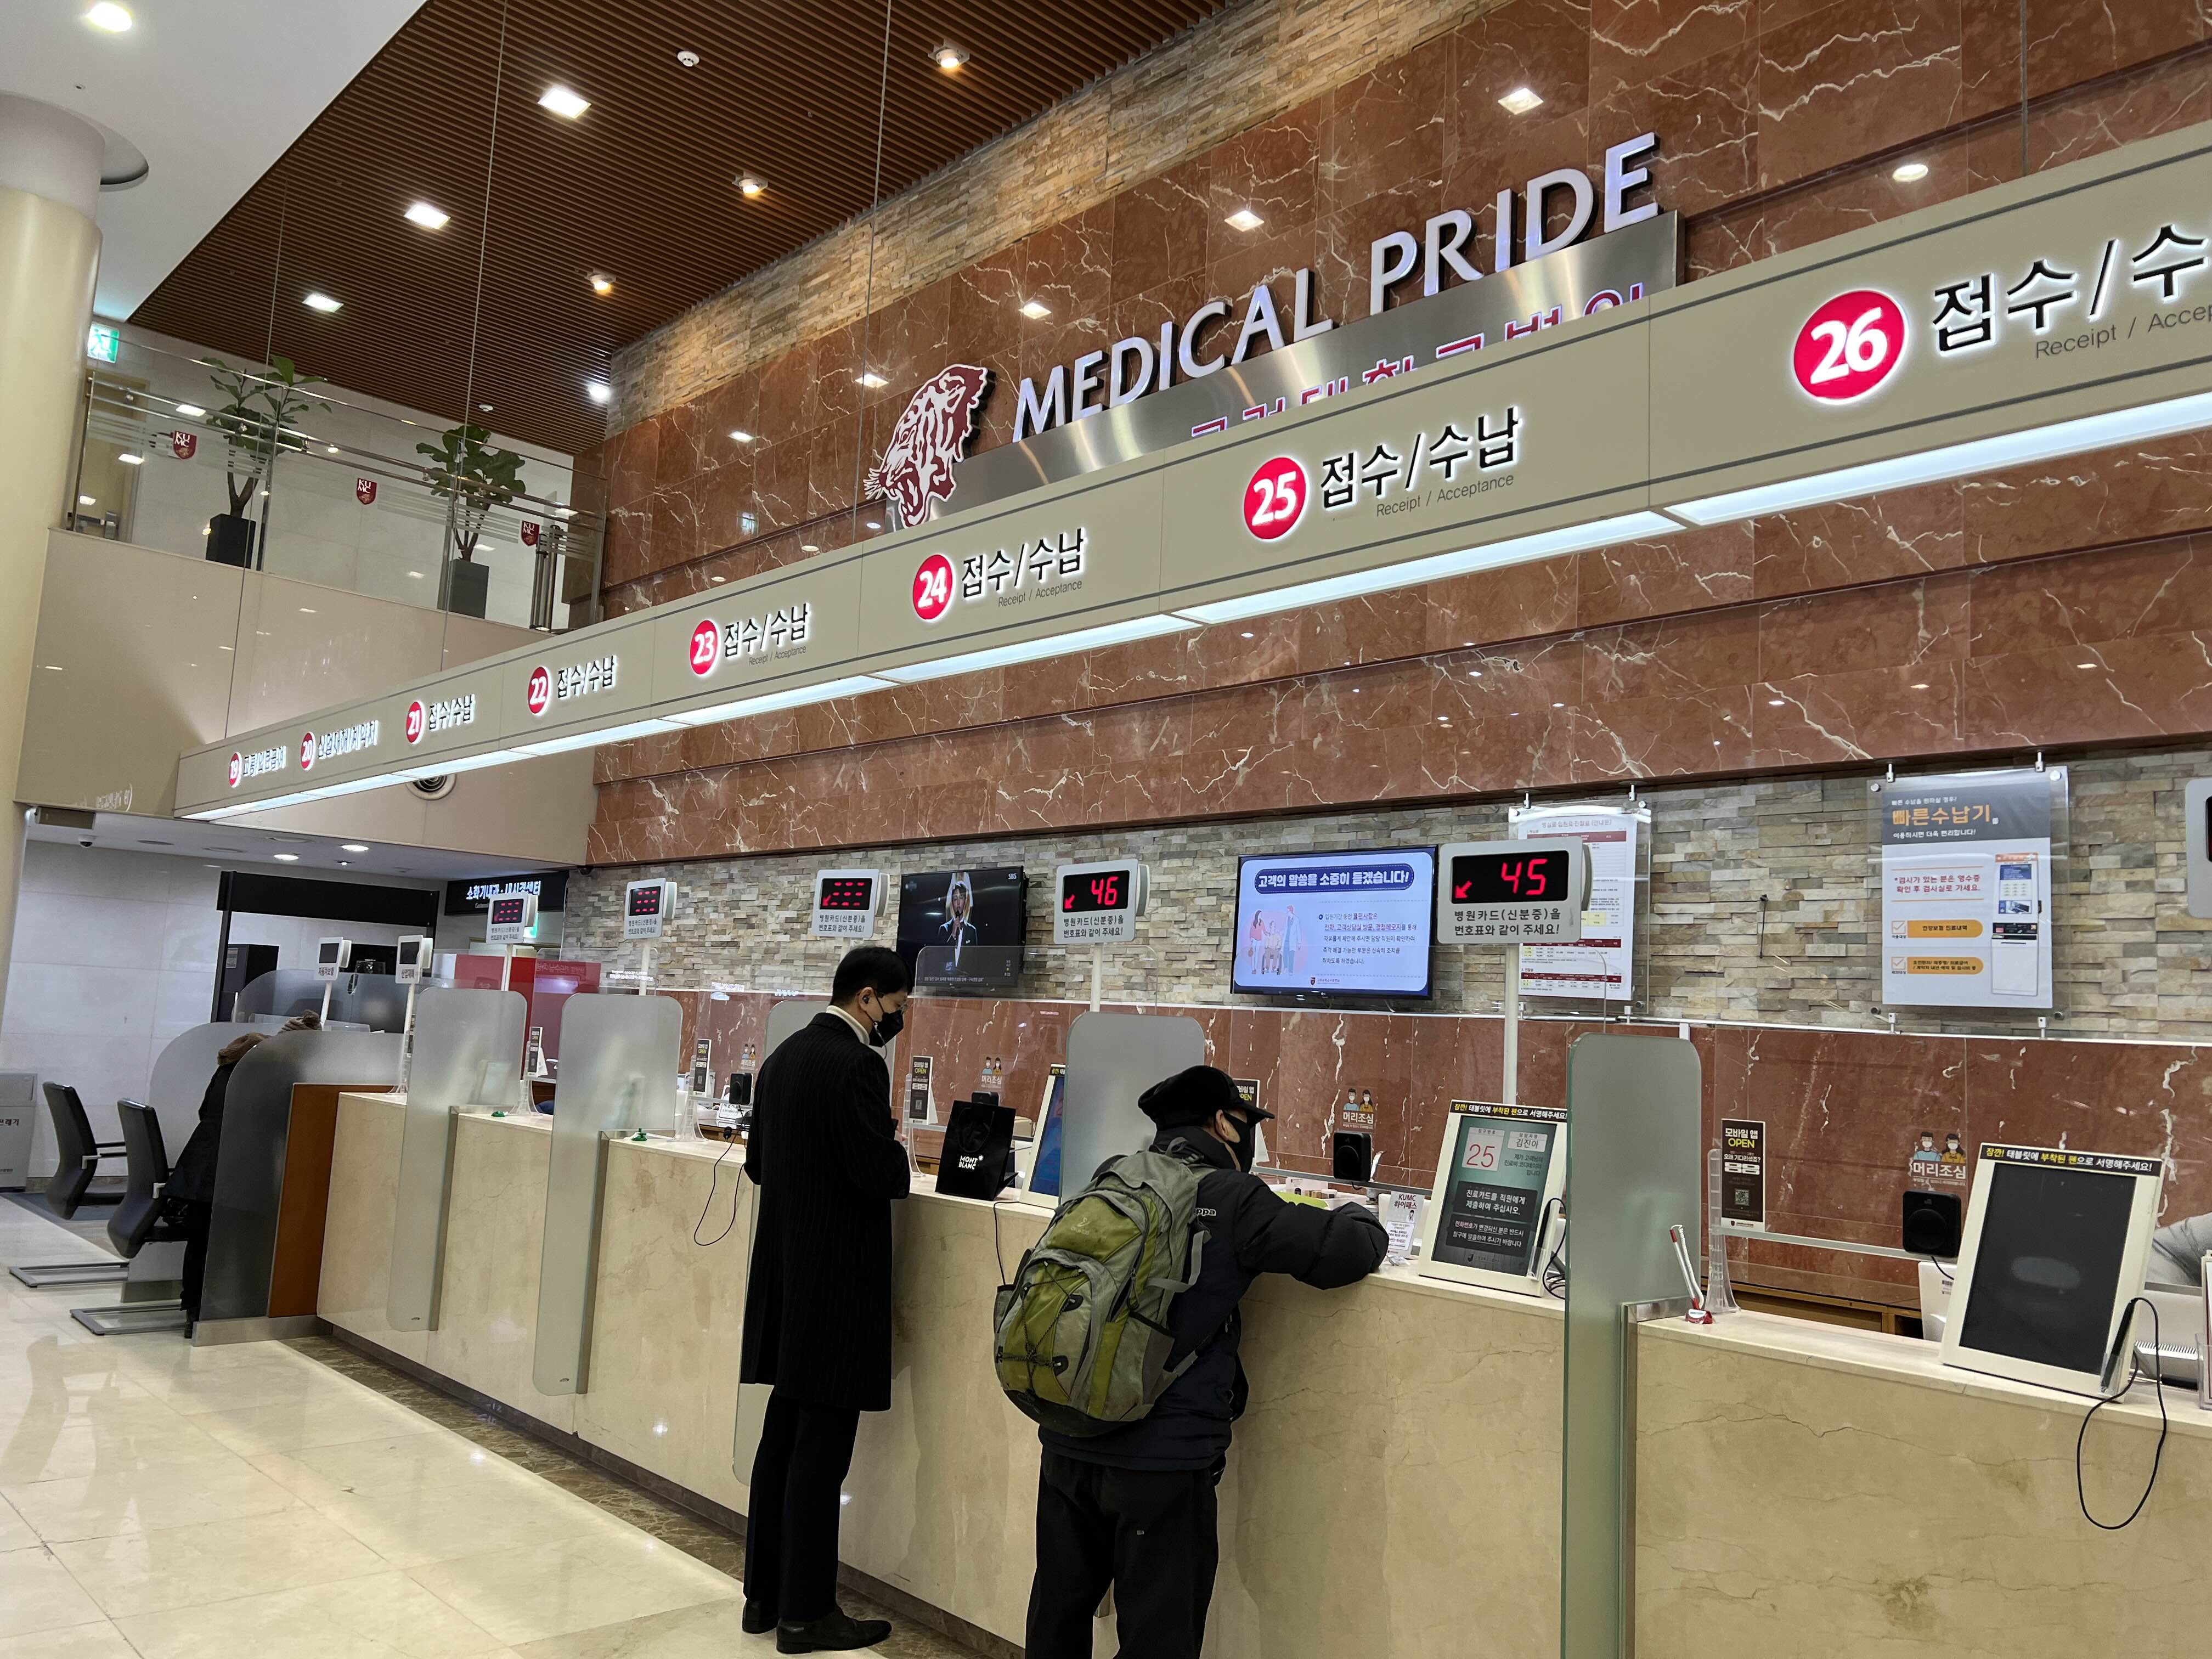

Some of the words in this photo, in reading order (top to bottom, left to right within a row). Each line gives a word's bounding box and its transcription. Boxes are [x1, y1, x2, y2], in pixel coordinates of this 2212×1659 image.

[1014, 269, 1334, 442] MEDICAL
[1370, 132, 1660, 315] PRIDE
[1809, 307, 1888, 384] 26
[2036, 324, 2117, 358] Receipt
[176, 432, 190, 441] KU
[1251, 477, 1297, 529] 25
[1322, 407, 1520, 509] 접수/수납
[359, 479, 371, 489] KU
[1376, 492, 1420, 517] Receipt
[1437, 472, 1514, 504] Acceptance
[523, 522, 534, 532] KU
[918, 572, 947, 607] 24
[962, 528, 1086, 599] 접수/수납
[998, 591, 1026, 607] Receipt
[1035, 581, 1082, 599] Acceptance
[695, 634, 716, 662] 23
[724, 604, 810, 657] 접수/수납
[774, 645, 806, 659] Acceptance
[530, 676, 546, 705] 22
[558, 655, 617, 700] 접수/수납
[408, 712, 420, 735] 21
[430, 694, 475, 731] 접수/수납
[302, 740, 312, 761] 20
[230, 759, 238, 779] 19
[1259, 875, 1286, 887] 고객의
[1289, 874, 1317, 887] 말씀을
[1319, 872, 1349, 885] 소중히
[1352, 871, 1409, 884] 듣겠습니다!
[1501, 858, 1548, 895] 45
[1091, 876, 1119, 906] 46
[1064, 916, 1124, 927] 병원카드(신분증)을
[1454, 908, 1561, 922] 병원카드(신분증)을
[1064, 929, 1086, 938] 번호표와
[1089, 928, 1101, 936] 같이
[1102, 928, 1123, 936] 주세요!
[1454, 924, 1495, 936] 번호표와
[1499, 924, 1519, 936] 같이
[1523, 924, 1559, 935] 주세요!
[981, 1075, 1002, 1085] 머리조심
[1343, 1111, 1374, 1124] 머리조심
[1530, 1110, 1567, 1120] 서명해주세요!
[1725, 1128, 1748, 1138] 모바일
[1750, 1130, 1758, 1139] 앱
[1516, 1138, 1538, 1149] 김진아
[1728, 1138, 1754, 1148] OPEN
[960, 1155, 978, 1164] MONT
[1466, 1144, 1495, 1167] 25
[1987, 1148, 2004, 1157] 잠깐!
[2007, 1149, 2039, 1161] 태블릿에
[2041, 1153, 2066, 1164] 부착된
[2069, 1156, 2094, 1165] 펜으로
[2096, 1158, 2152, 1172] 서명해주세요!
[958, 1161, 976, 1170] BLANC
[1913, 1163, 1966, 1179] 머리조심
[1466, 1189, 1497, 1201] 진료카드를
[1500, 1194, 1526, 1205] 직원에게
[1194, 1208, 1216, 1216] ppa
[1394, 1201, 1417, 1209] 하이패스
[1466, 1200, 1491, 1210] 제출하여
[1493, 1204, 1520, 1215] 주십시오.
[1509, 1228, 1523, 1237] 반드시
[1468, 1233, 1486, 1242] 말씀하여
[1503, 1239, 1521, 1248] 바랍니다
